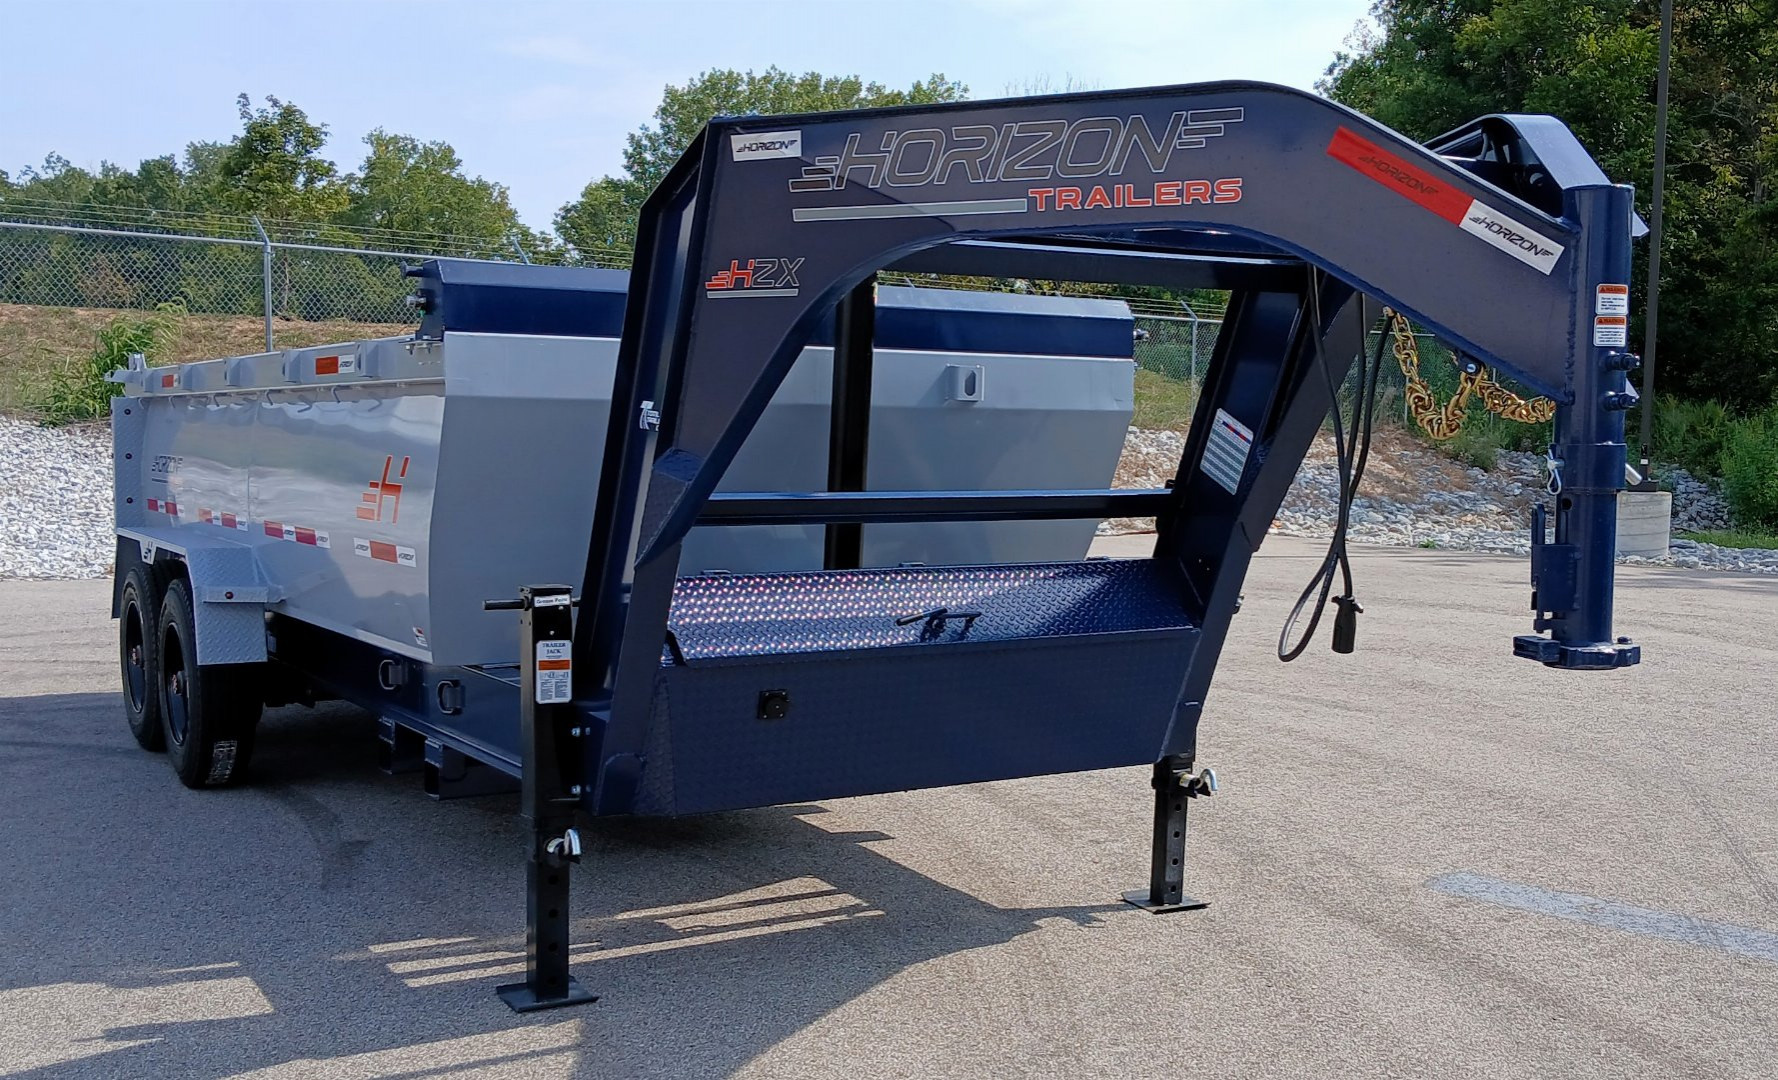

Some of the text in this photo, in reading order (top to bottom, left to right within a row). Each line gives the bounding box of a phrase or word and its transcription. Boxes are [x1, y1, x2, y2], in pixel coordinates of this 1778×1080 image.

[742, 140, 790, 152] HORIZON
[831, 111, 1188, 191] HORIZON
[1367, 156, 1430, 194] HORIZON
[1028, 177, 1243, 212] TRAILERS
[1478, 216, 1546, 256] HORIZON
